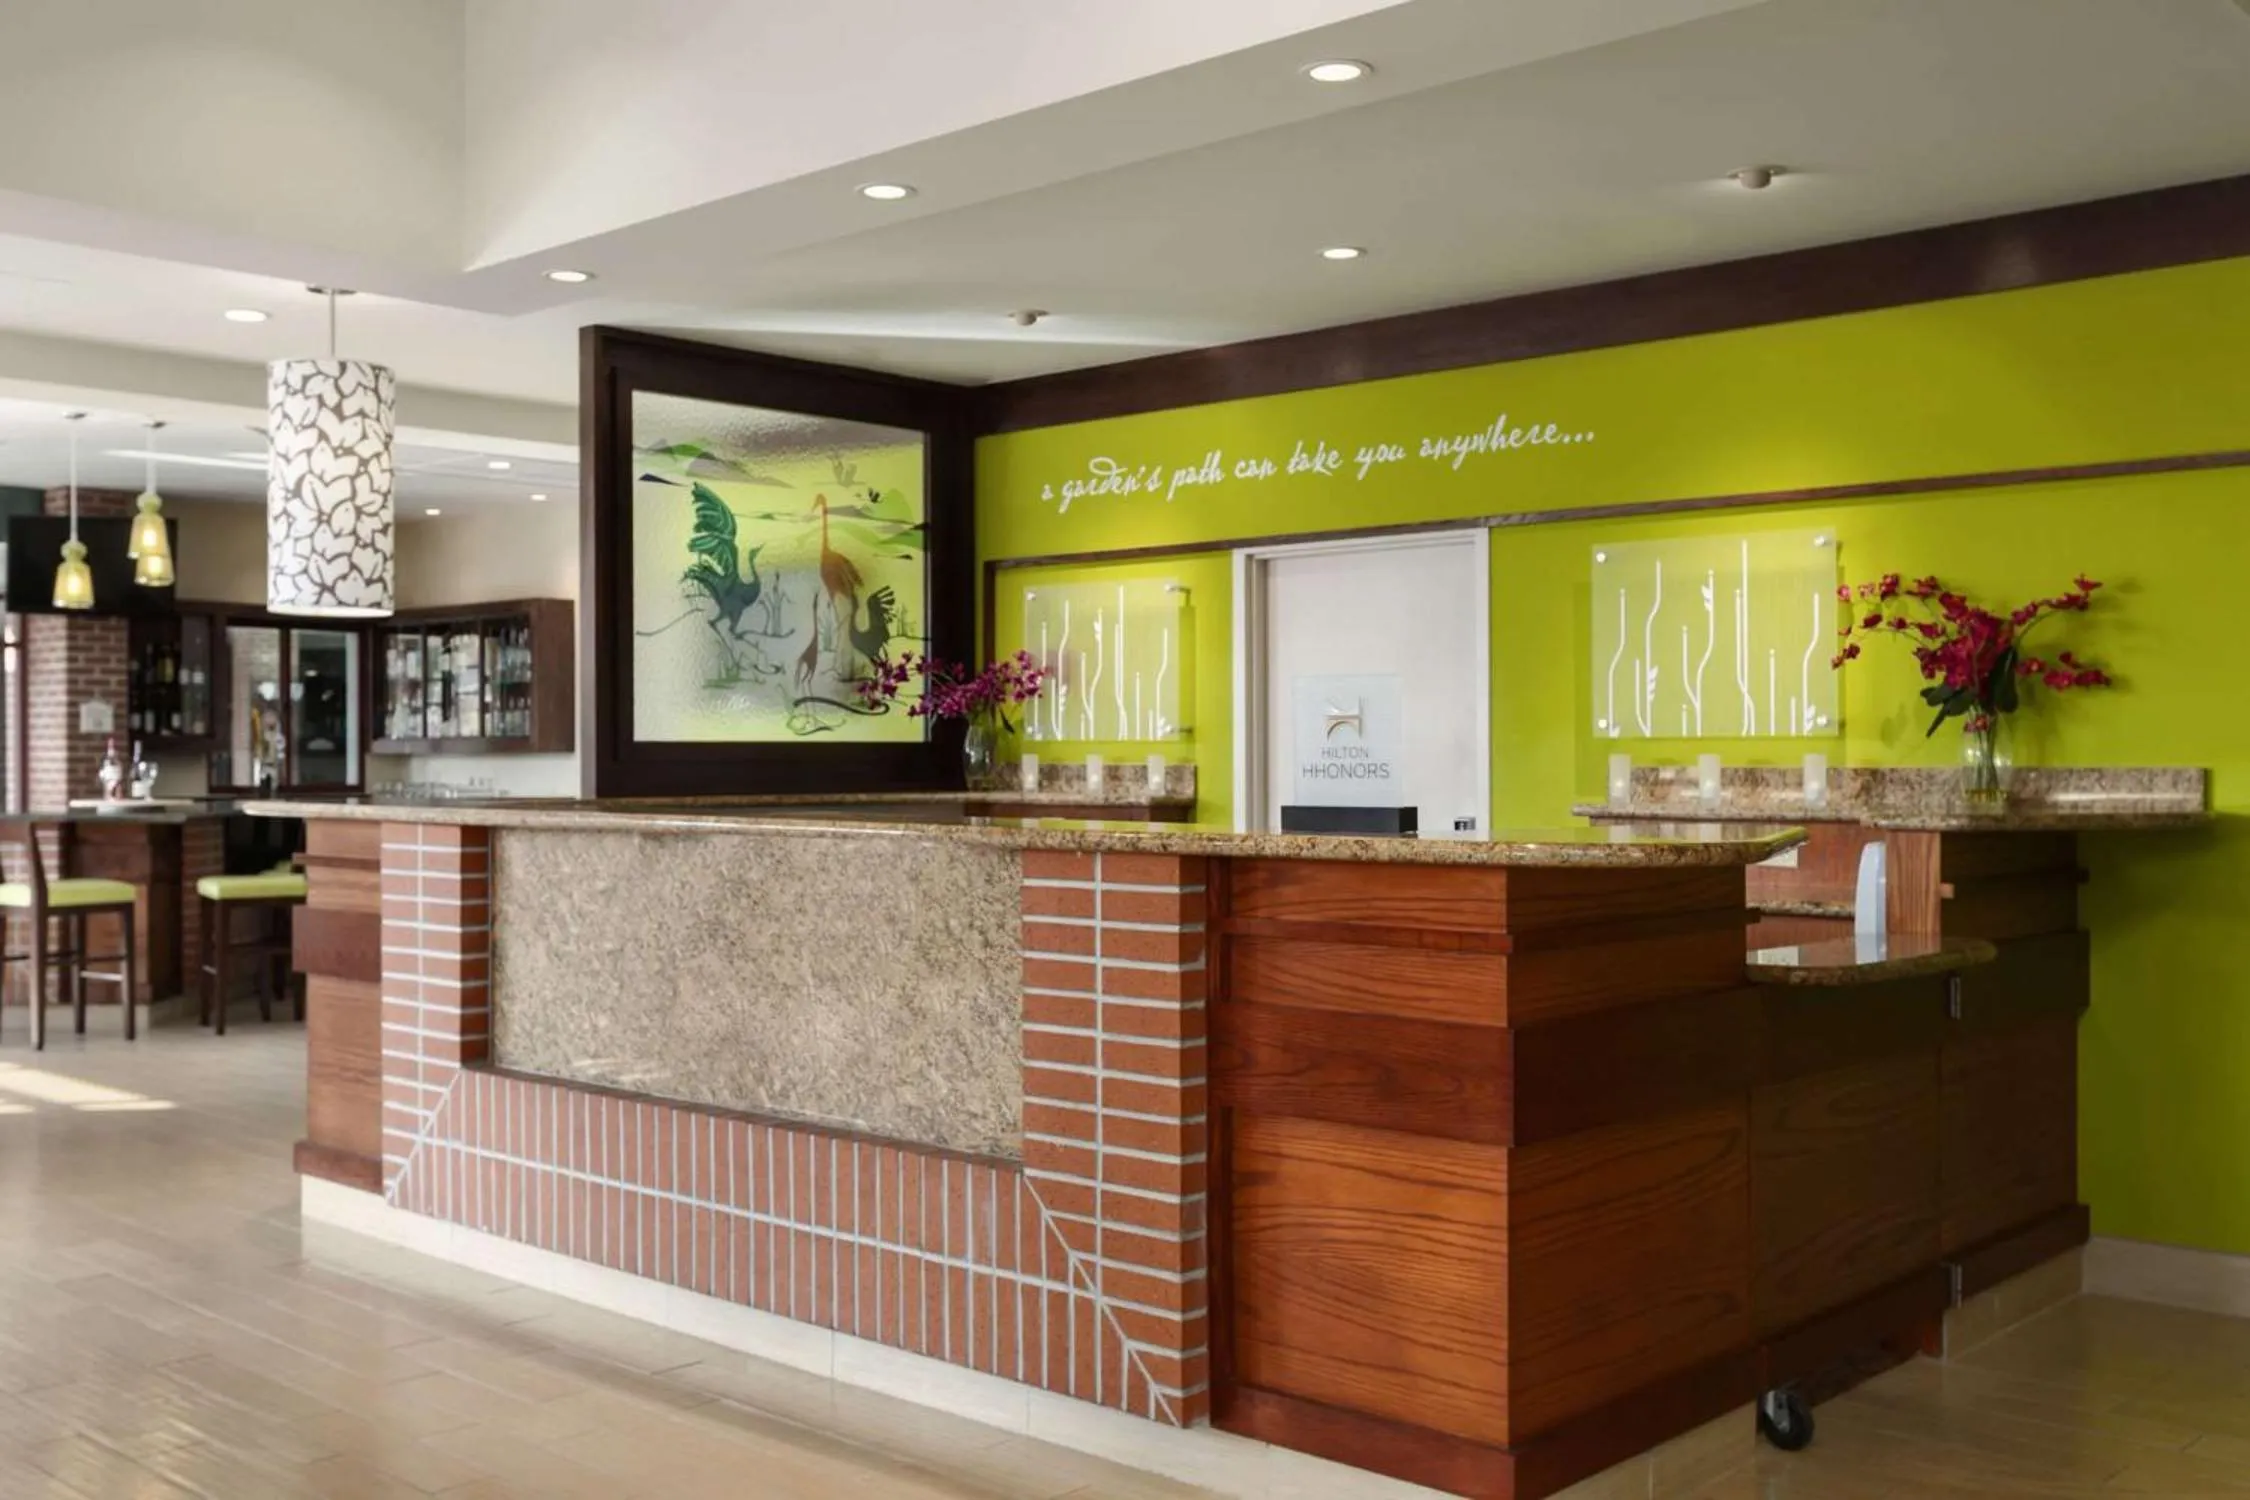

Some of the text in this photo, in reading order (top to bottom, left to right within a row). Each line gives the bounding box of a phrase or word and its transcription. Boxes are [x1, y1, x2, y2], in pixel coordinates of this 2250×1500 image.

[1041, 413, 1595, 514] a garden's path can take you anywhere...
[1321, 746, 1369, 760] HILTON
[1302, 762, 1391, 780] HHONORS
